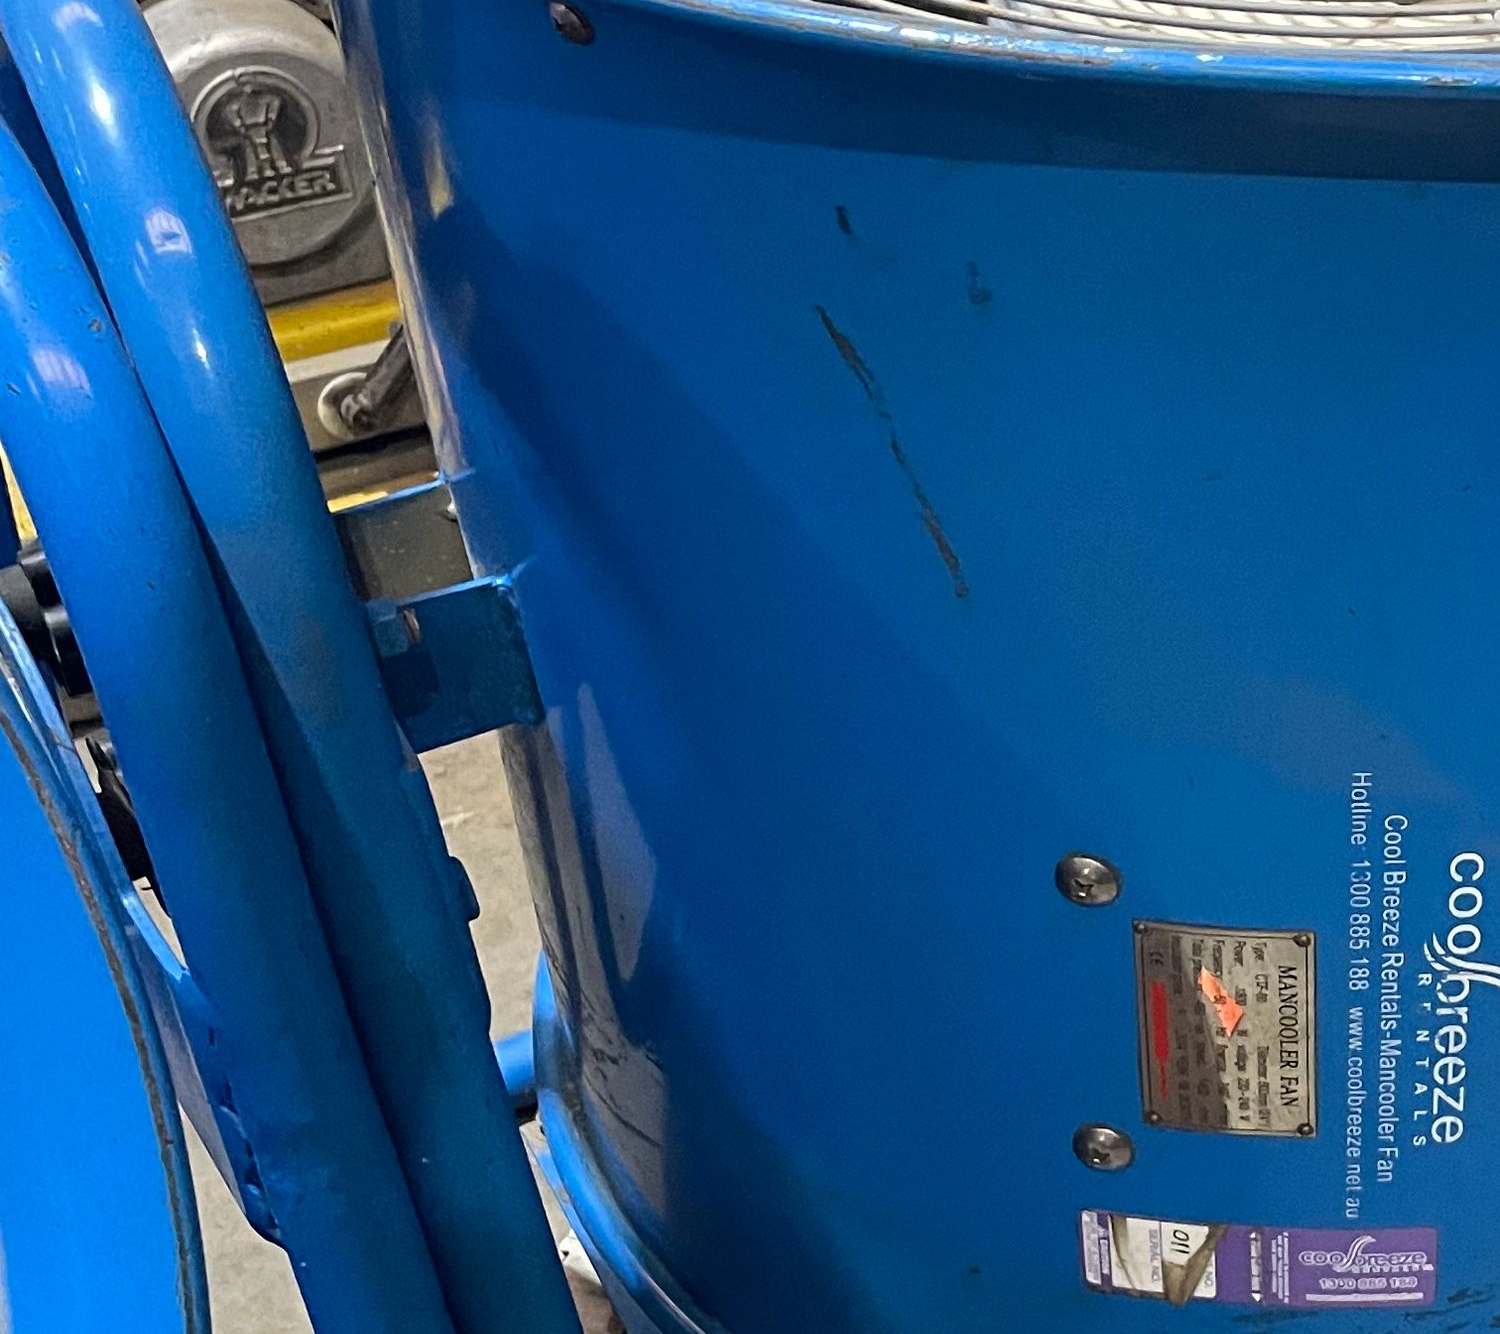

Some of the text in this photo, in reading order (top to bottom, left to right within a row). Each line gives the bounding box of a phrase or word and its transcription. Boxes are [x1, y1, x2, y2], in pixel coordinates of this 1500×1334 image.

[1349, 859, 1372, 908] 1300
[1349, 913, 1371, 950] 885
[1348, 957, 1370, 991] 188
[1376, 814, 1409, 1183] Cool Breeze Rentals-Mancooler Fan
[1278, 965, 1300, 1107] MANCOOLER FAN
[1149, 1228, 1161, 1263] SERIAL
